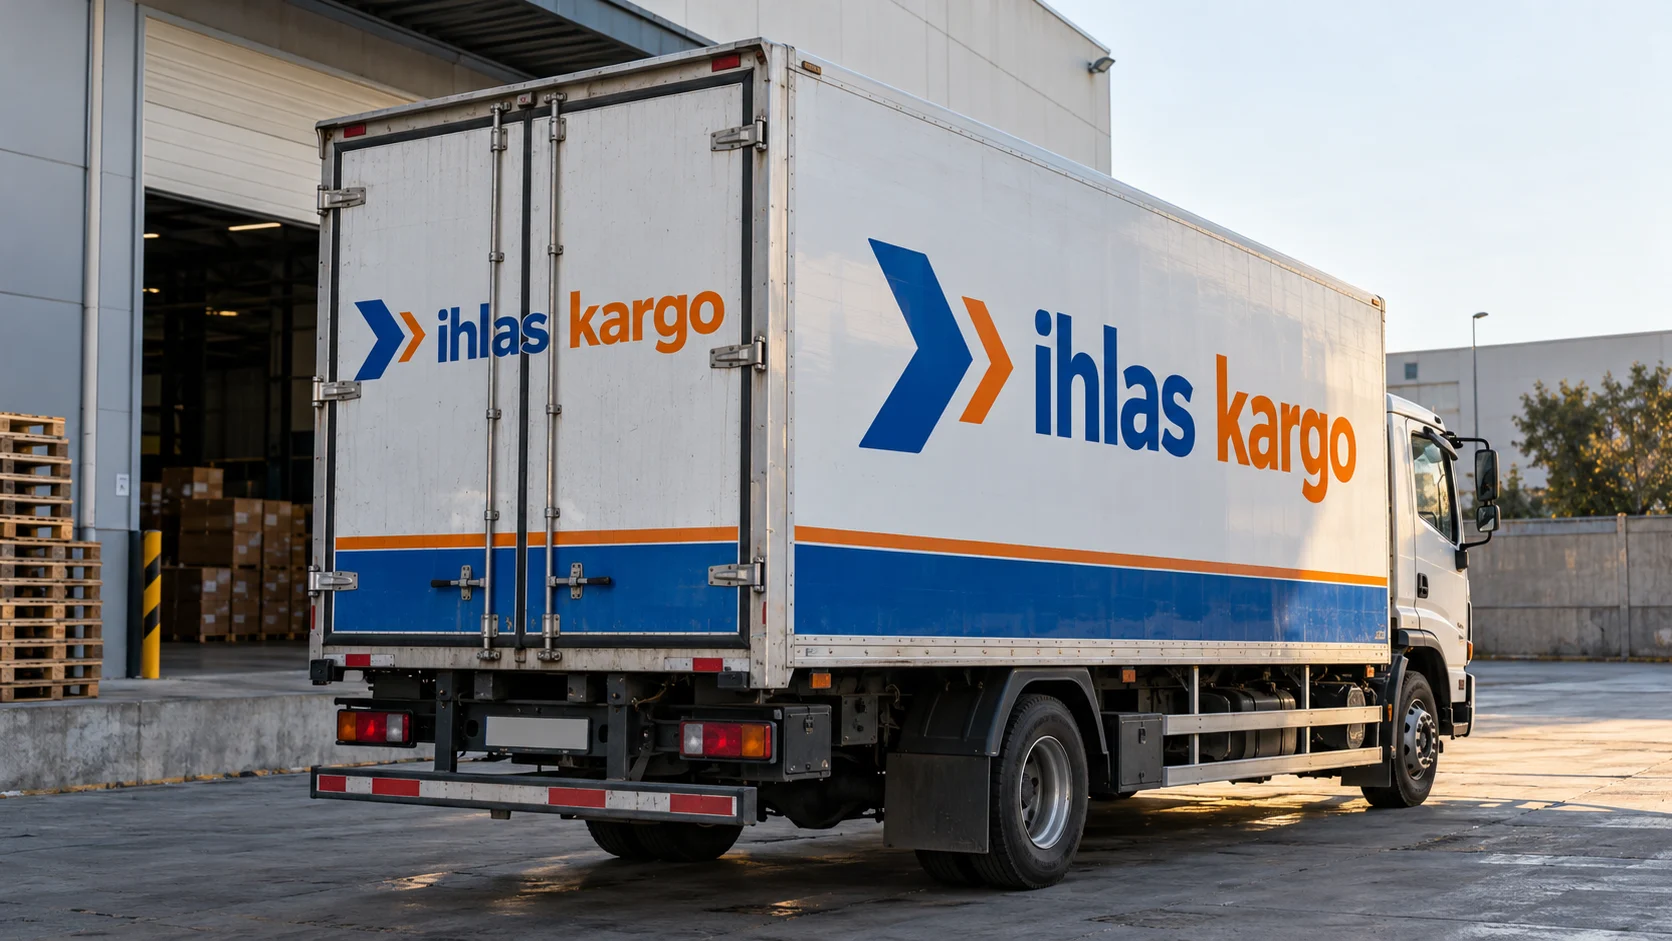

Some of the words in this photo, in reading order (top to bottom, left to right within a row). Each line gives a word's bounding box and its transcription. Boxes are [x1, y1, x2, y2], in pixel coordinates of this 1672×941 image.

[437, 302, 550, 363] ihlas
[569, 290, 725, 354] kargo
[1034, 309, 1196, 458] ihlas
[1216, 353, 1357, 504] kargo
